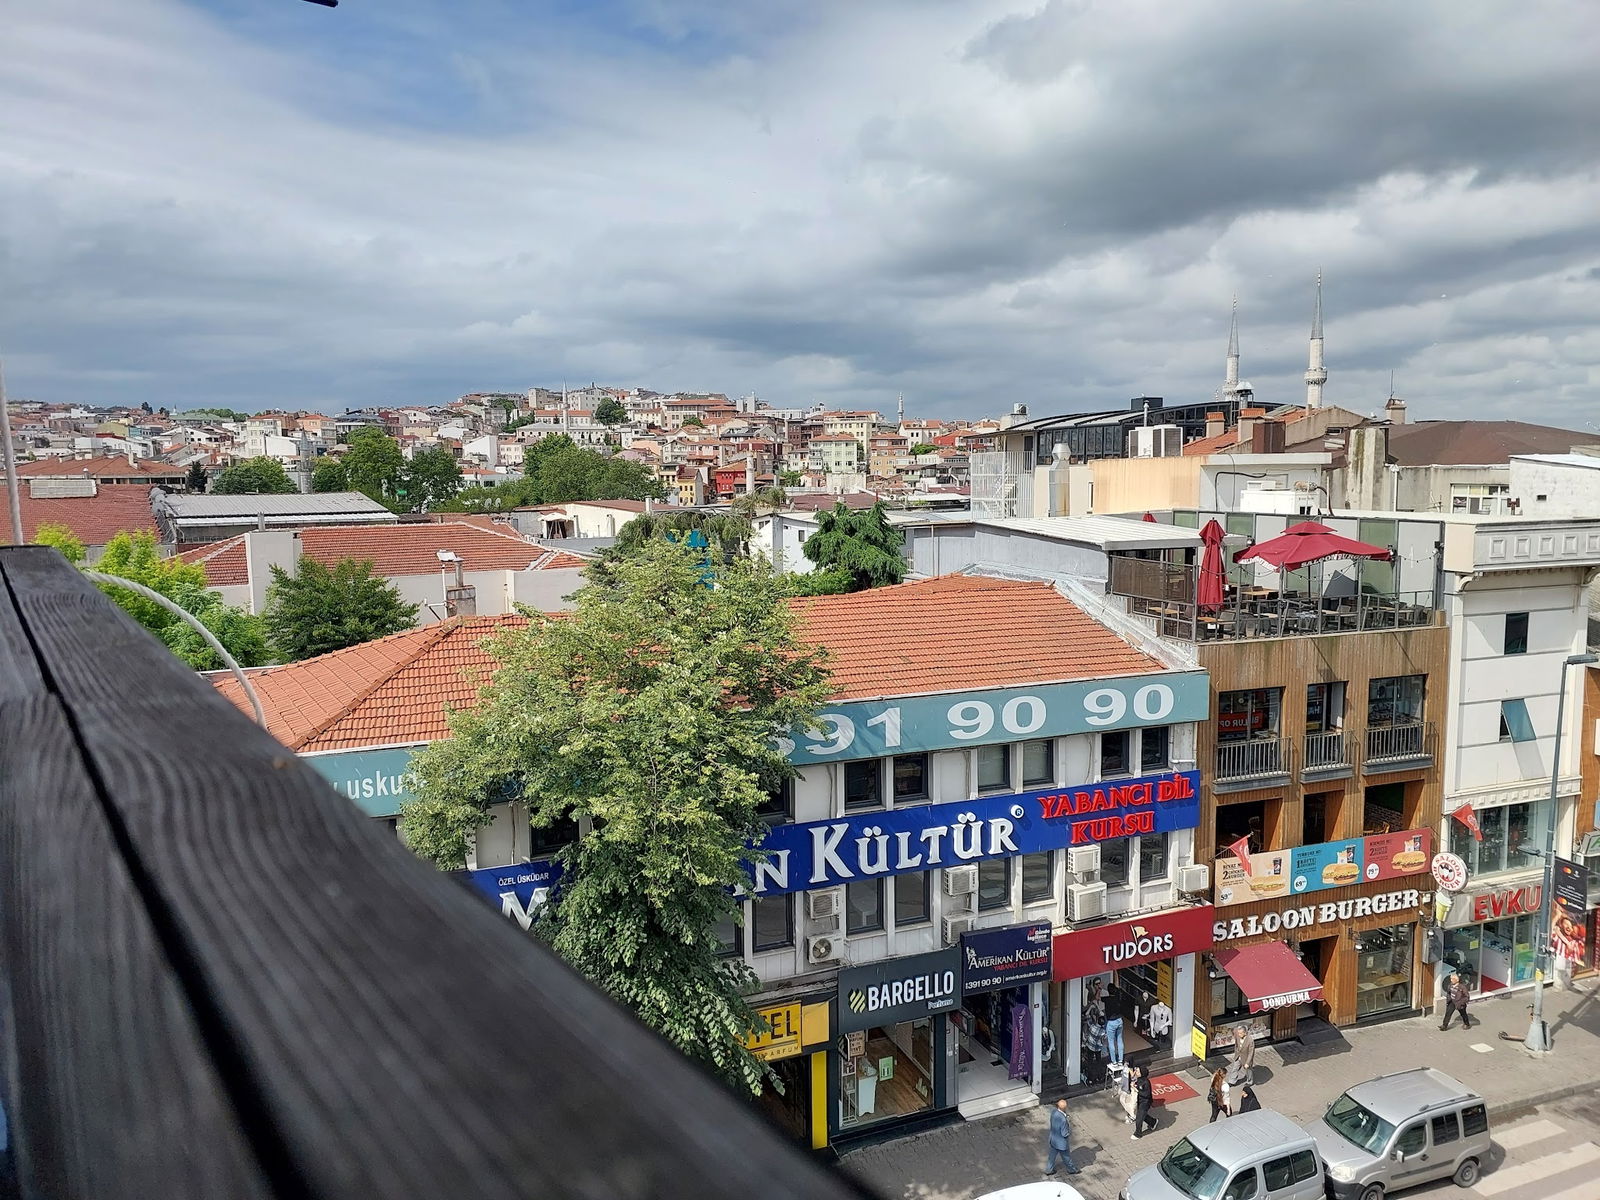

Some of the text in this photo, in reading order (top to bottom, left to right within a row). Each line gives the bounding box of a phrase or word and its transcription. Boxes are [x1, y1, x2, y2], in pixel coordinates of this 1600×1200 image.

[946, 695, 1047, 740] 90
[1083, 684, 1174, 726] 90
[1037, 774, 1195, 819] YABANCI DİL
[1071, 811, 1155, 844] KURSU
[808, 812, 1019, 884] KÜLTÜR
[498, 872, 549, 887] ÖZEL ÜSKÜDAR
[1222, 870, 1229, 880] 2
[1436, 855, 1462, 878] SALOON
[1212, 888, 1420, 942] SALOON BURGER
[1474, 884, 1543, 921] EVKU
[968, 949, 1048, 970] AMERİKAN KÜLTÜR
[1102, 933, 1174, 964] TUDORS
[868, 970, 954, 1012] BARGELLO
[981, 978, 991, 987] 90
[992, 976, 1002, 985] 90
[1262, 991, 1311, 1009] DONDURMA
[1152, 1083, 1184, 1096] UDORS
